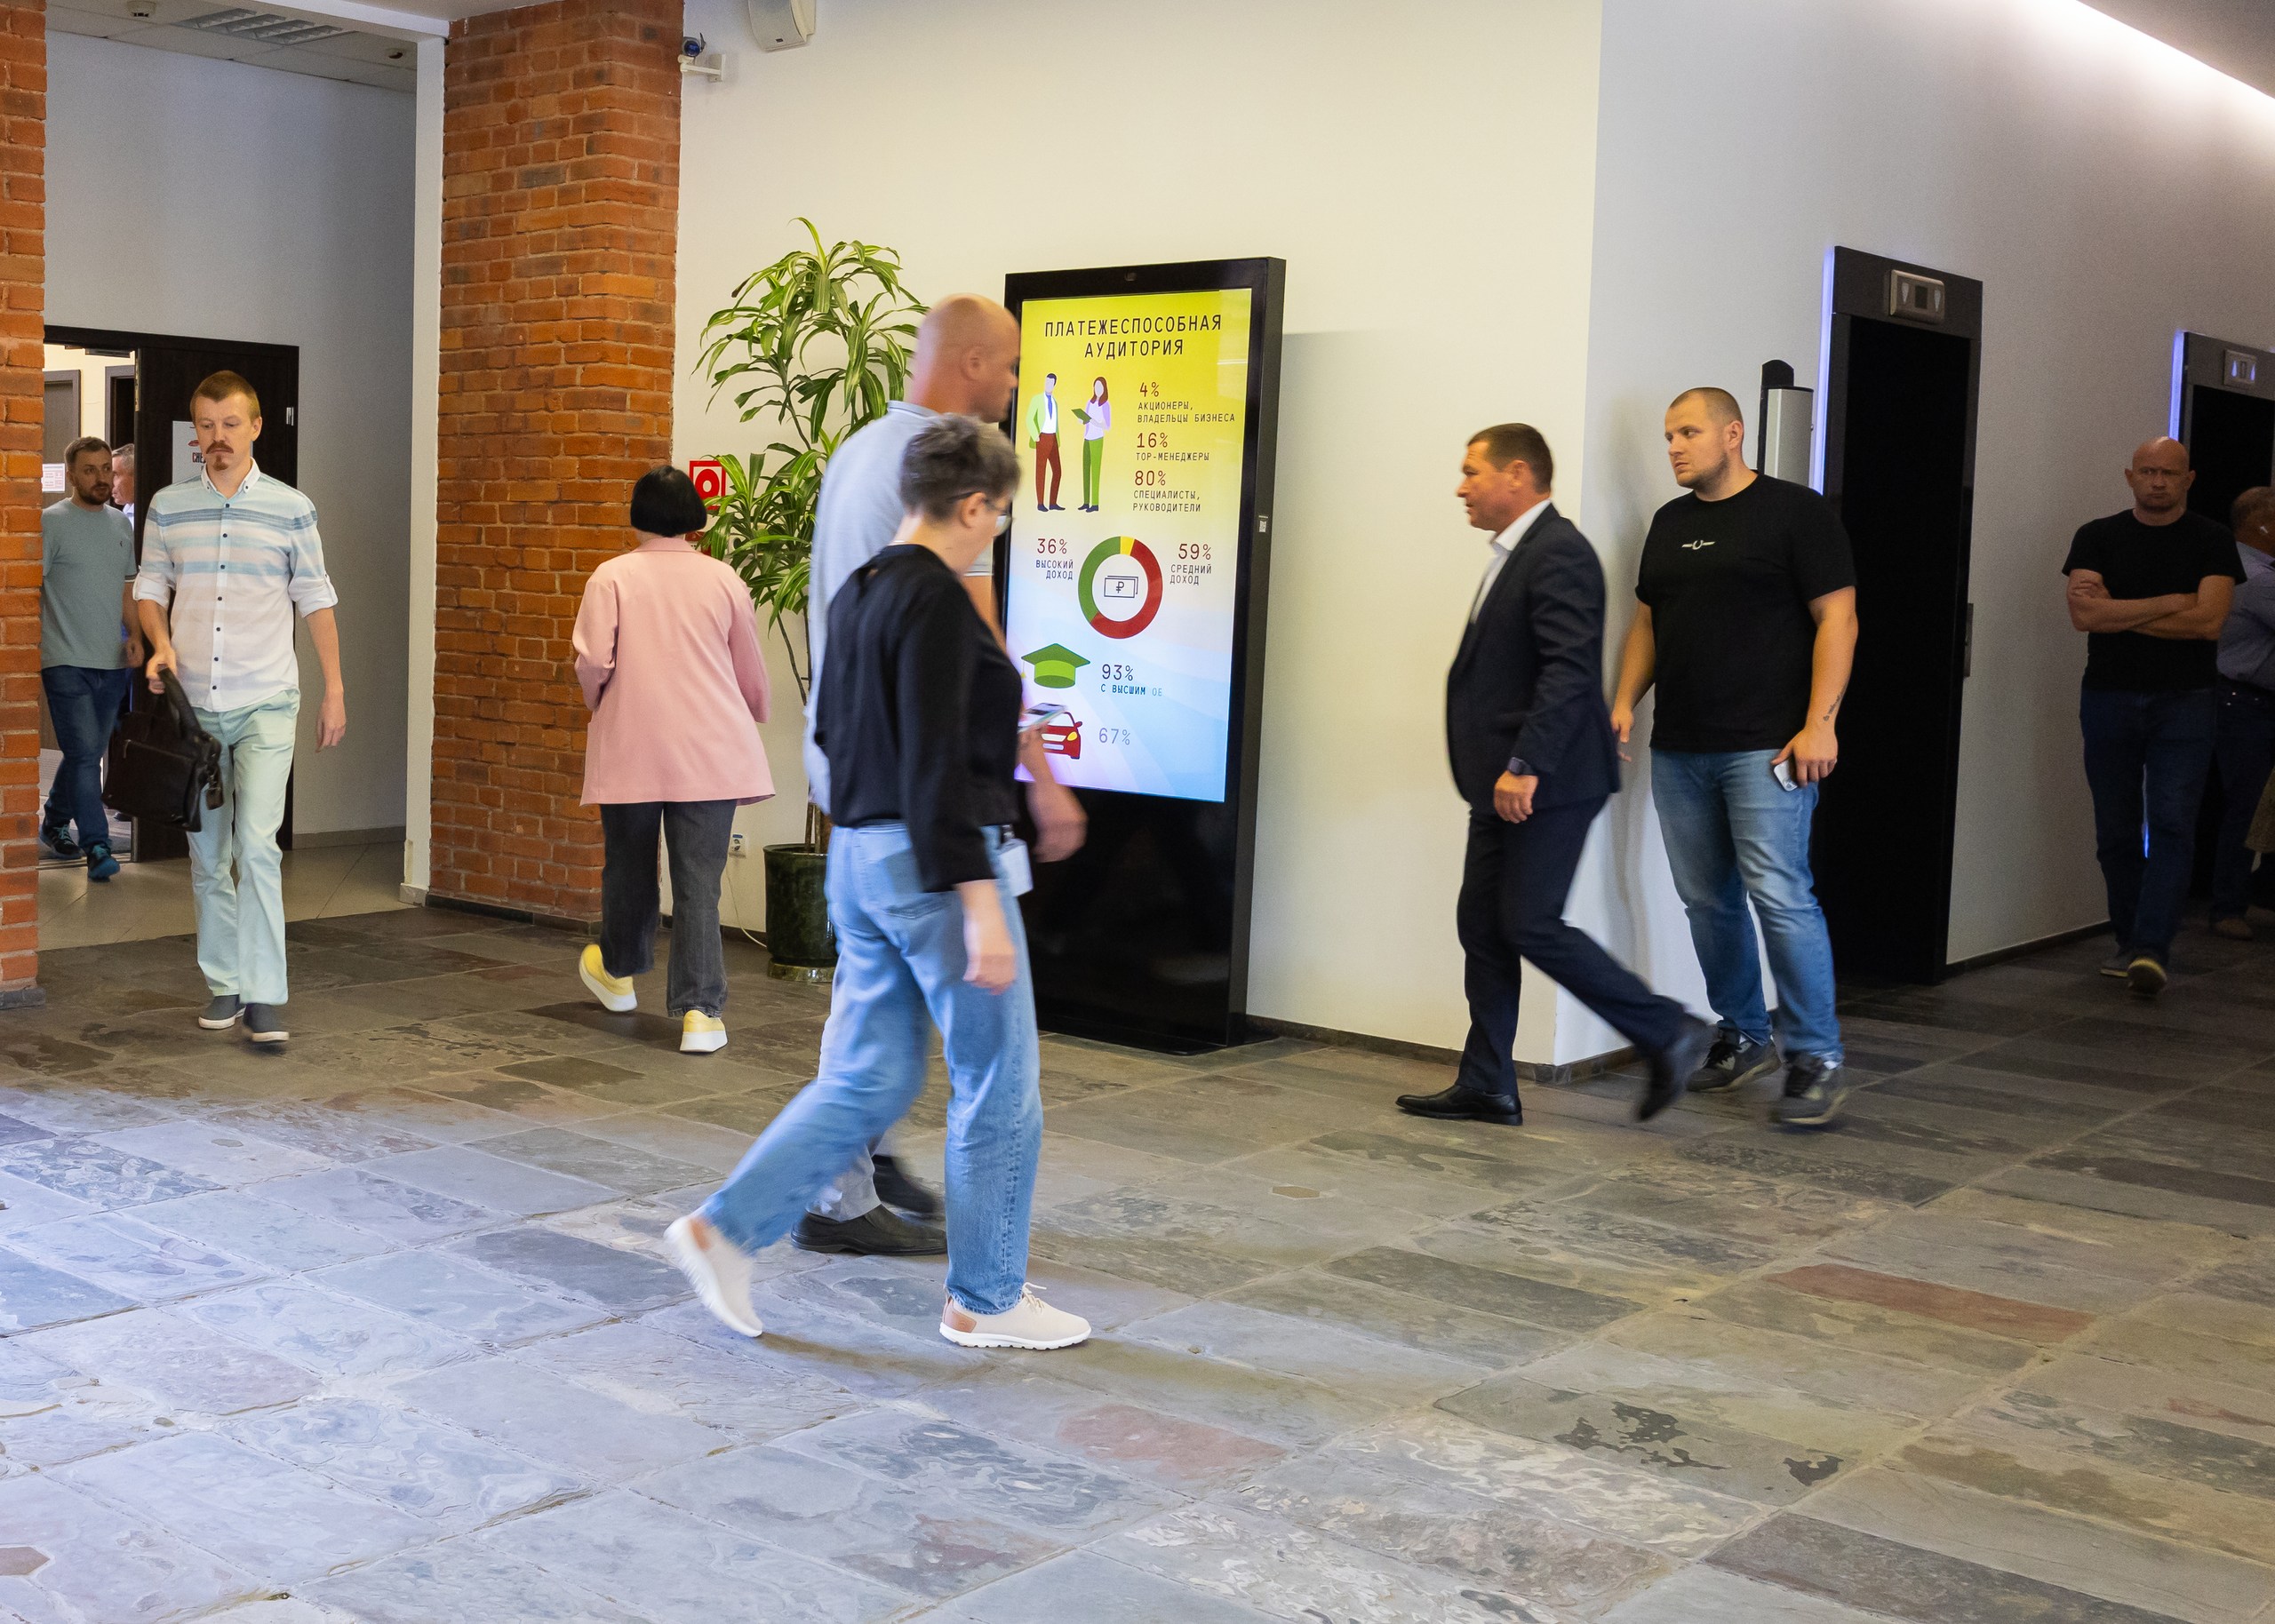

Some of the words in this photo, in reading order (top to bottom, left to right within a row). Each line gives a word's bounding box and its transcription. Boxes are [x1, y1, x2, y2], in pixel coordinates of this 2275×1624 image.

[1044, 314, 1222, 337] ПЛАТЕЖЕСПОСОБНАЯ
[1084, 338, 1184, 360] АУДИТОРИЯ
[1139, 382, 1160, 397] 4%
[1138, 401, 1194, 411] АКЦИОНЕРЫ,
[1138, 412, 1189, 424] ВЛАДЕЛЬЦЫ
[1194, 412, 1235, 423] БИЗНЕСА
[1137, 432, 1169, 449] 16%
[1135, 470, 1166, 486] 80%
[1133, 490, 1201, 500] СПЕЦИАЛИСТЫ,
[1132, 501, 1201, 513] РУКОВОДИТЕЛИ
[1036, 537, 1067, 554] 36%
[1177, 543, 1211, 561] 59%
[1035, 560, 1074, 569] ВЫСОКИЙ
[1170, 563, 1212, 575] СРЕДНИЙ
[1045, 569, 1074, 580] ДОХОД
[1169, 575, 1200, 585] ДОХОД
[1101, 664, 1134, 682] 93%
[1112, 684, 1146, 696] ВЫСШИМ
[1098, 728, 1131, 745] 67%
